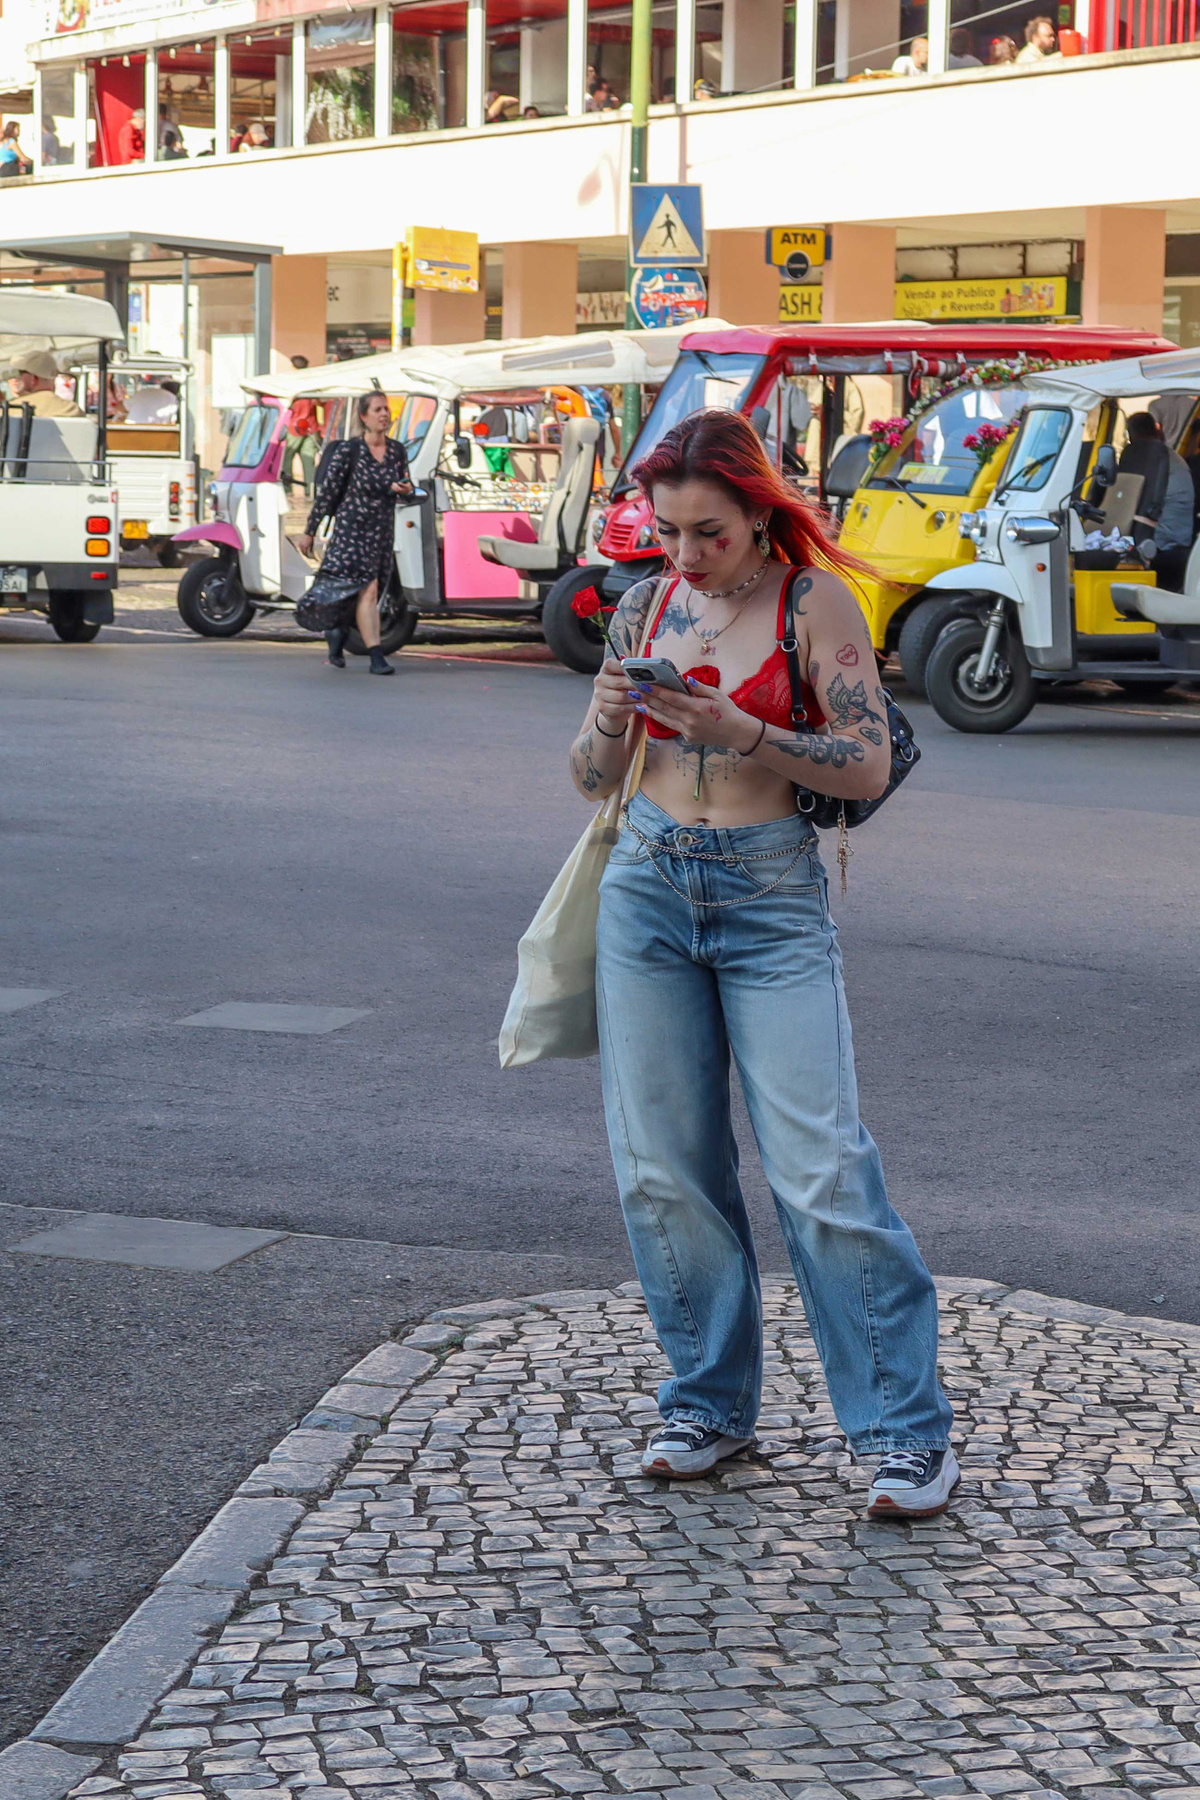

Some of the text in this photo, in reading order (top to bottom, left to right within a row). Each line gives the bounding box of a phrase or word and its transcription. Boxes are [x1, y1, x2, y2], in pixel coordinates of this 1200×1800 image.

[780, 232, 817, 244] ATM
[904, 288, 936, 299] Venda
[941, 289, 954, 298] ao
[941, 303, 947, 312] e
[951, 300, 995, 311] Revenda
